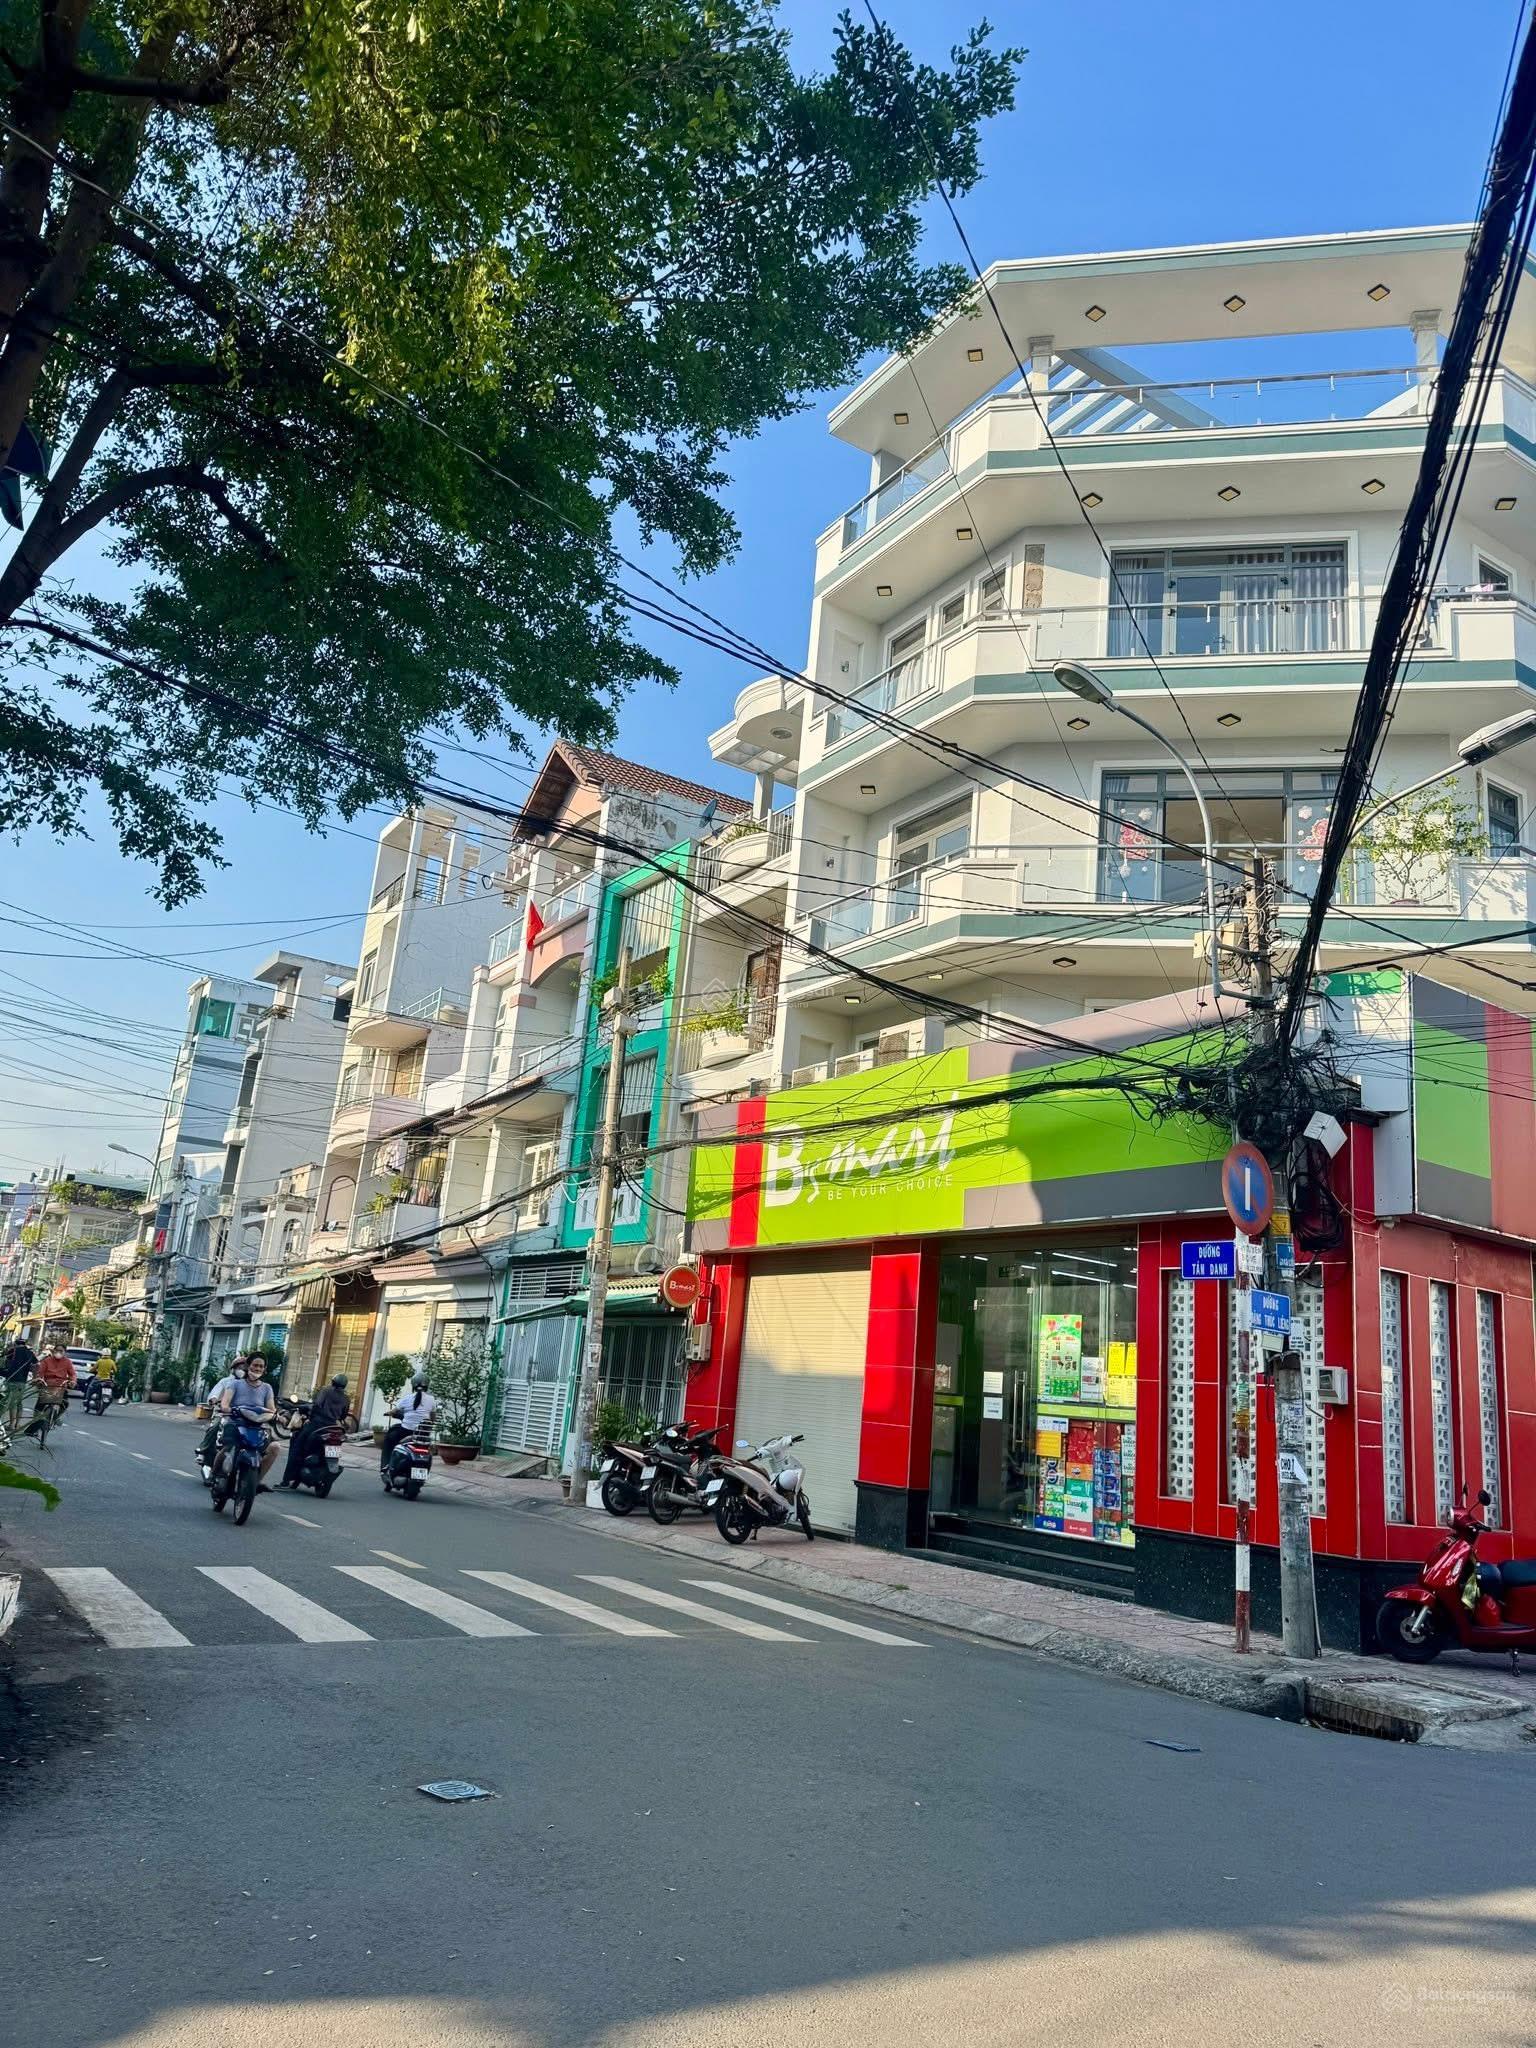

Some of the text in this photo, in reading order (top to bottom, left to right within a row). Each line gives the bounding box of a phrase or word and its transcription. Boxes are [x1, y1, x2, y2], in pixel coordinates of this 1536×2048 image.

[828, 1174, 953, 1201] BE YOUR CHOICE
